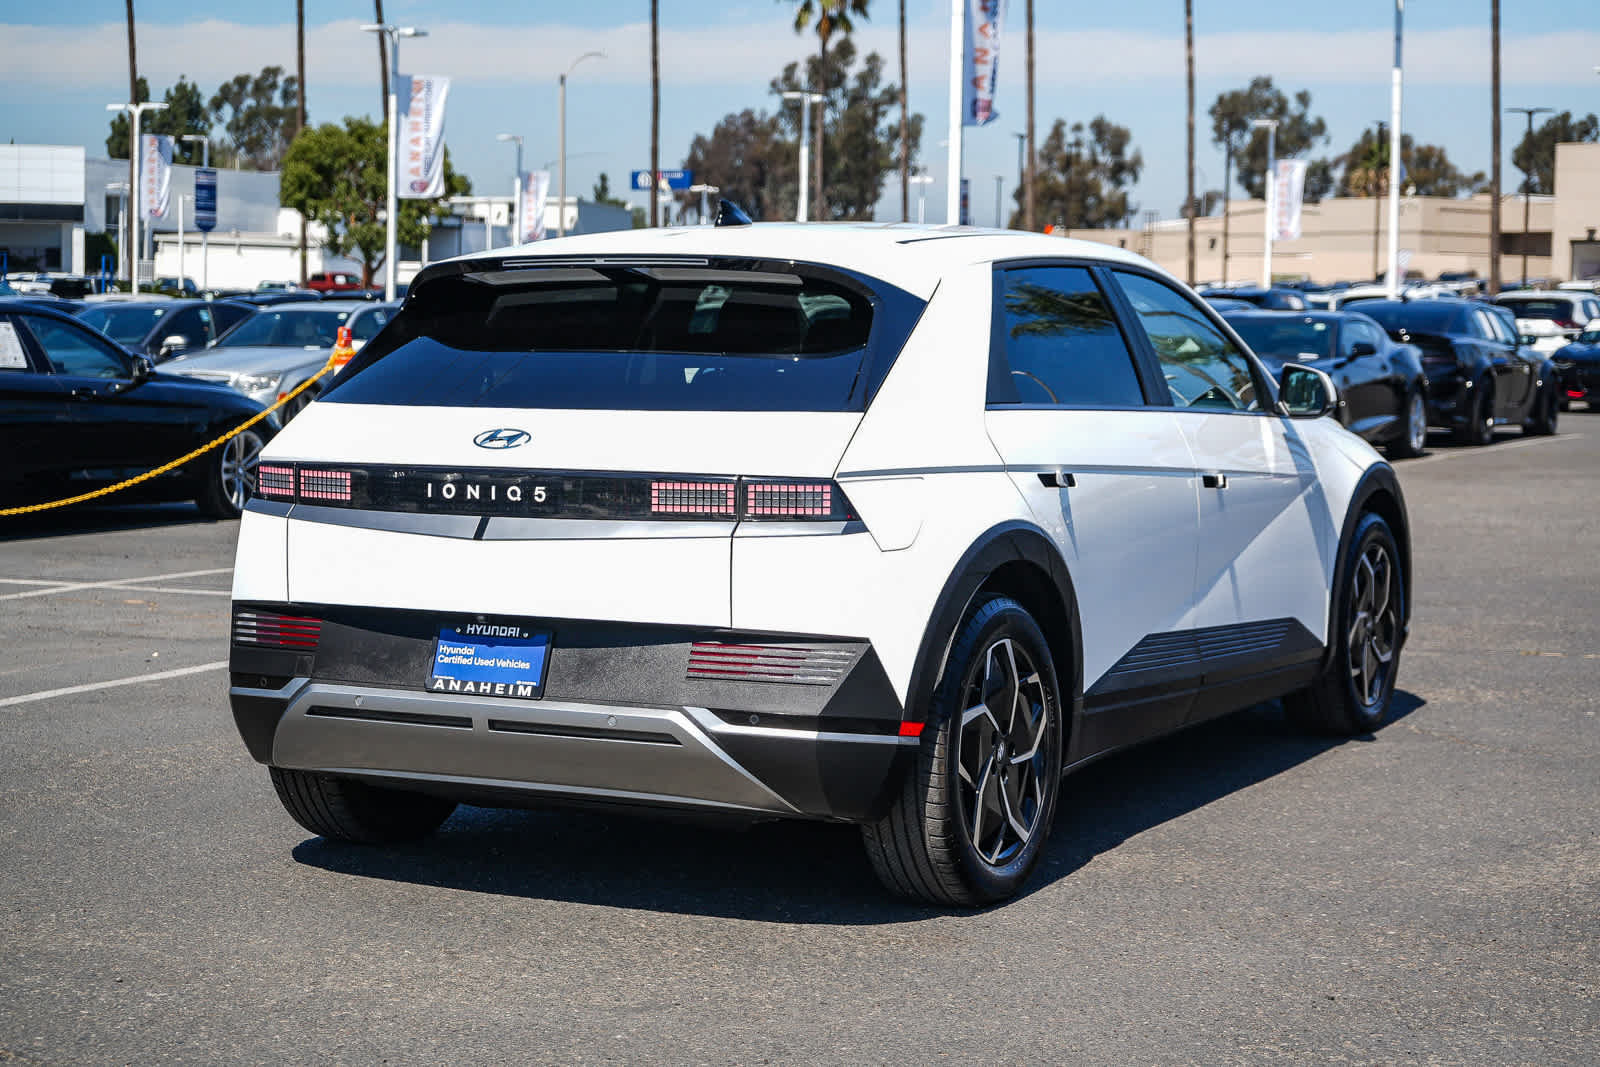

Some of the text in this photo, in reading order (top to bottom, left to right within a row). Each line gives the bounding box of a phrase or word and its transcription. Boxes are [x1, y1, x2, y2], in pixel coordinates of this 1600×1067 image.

[466, 624, 520, 637] HYUNDAI
[439, 645, 475, 656] Hyundai
[437, 655, 530, 669] Certified Used Vehicles
[433, 679, 532, 697] ANAHEIM
